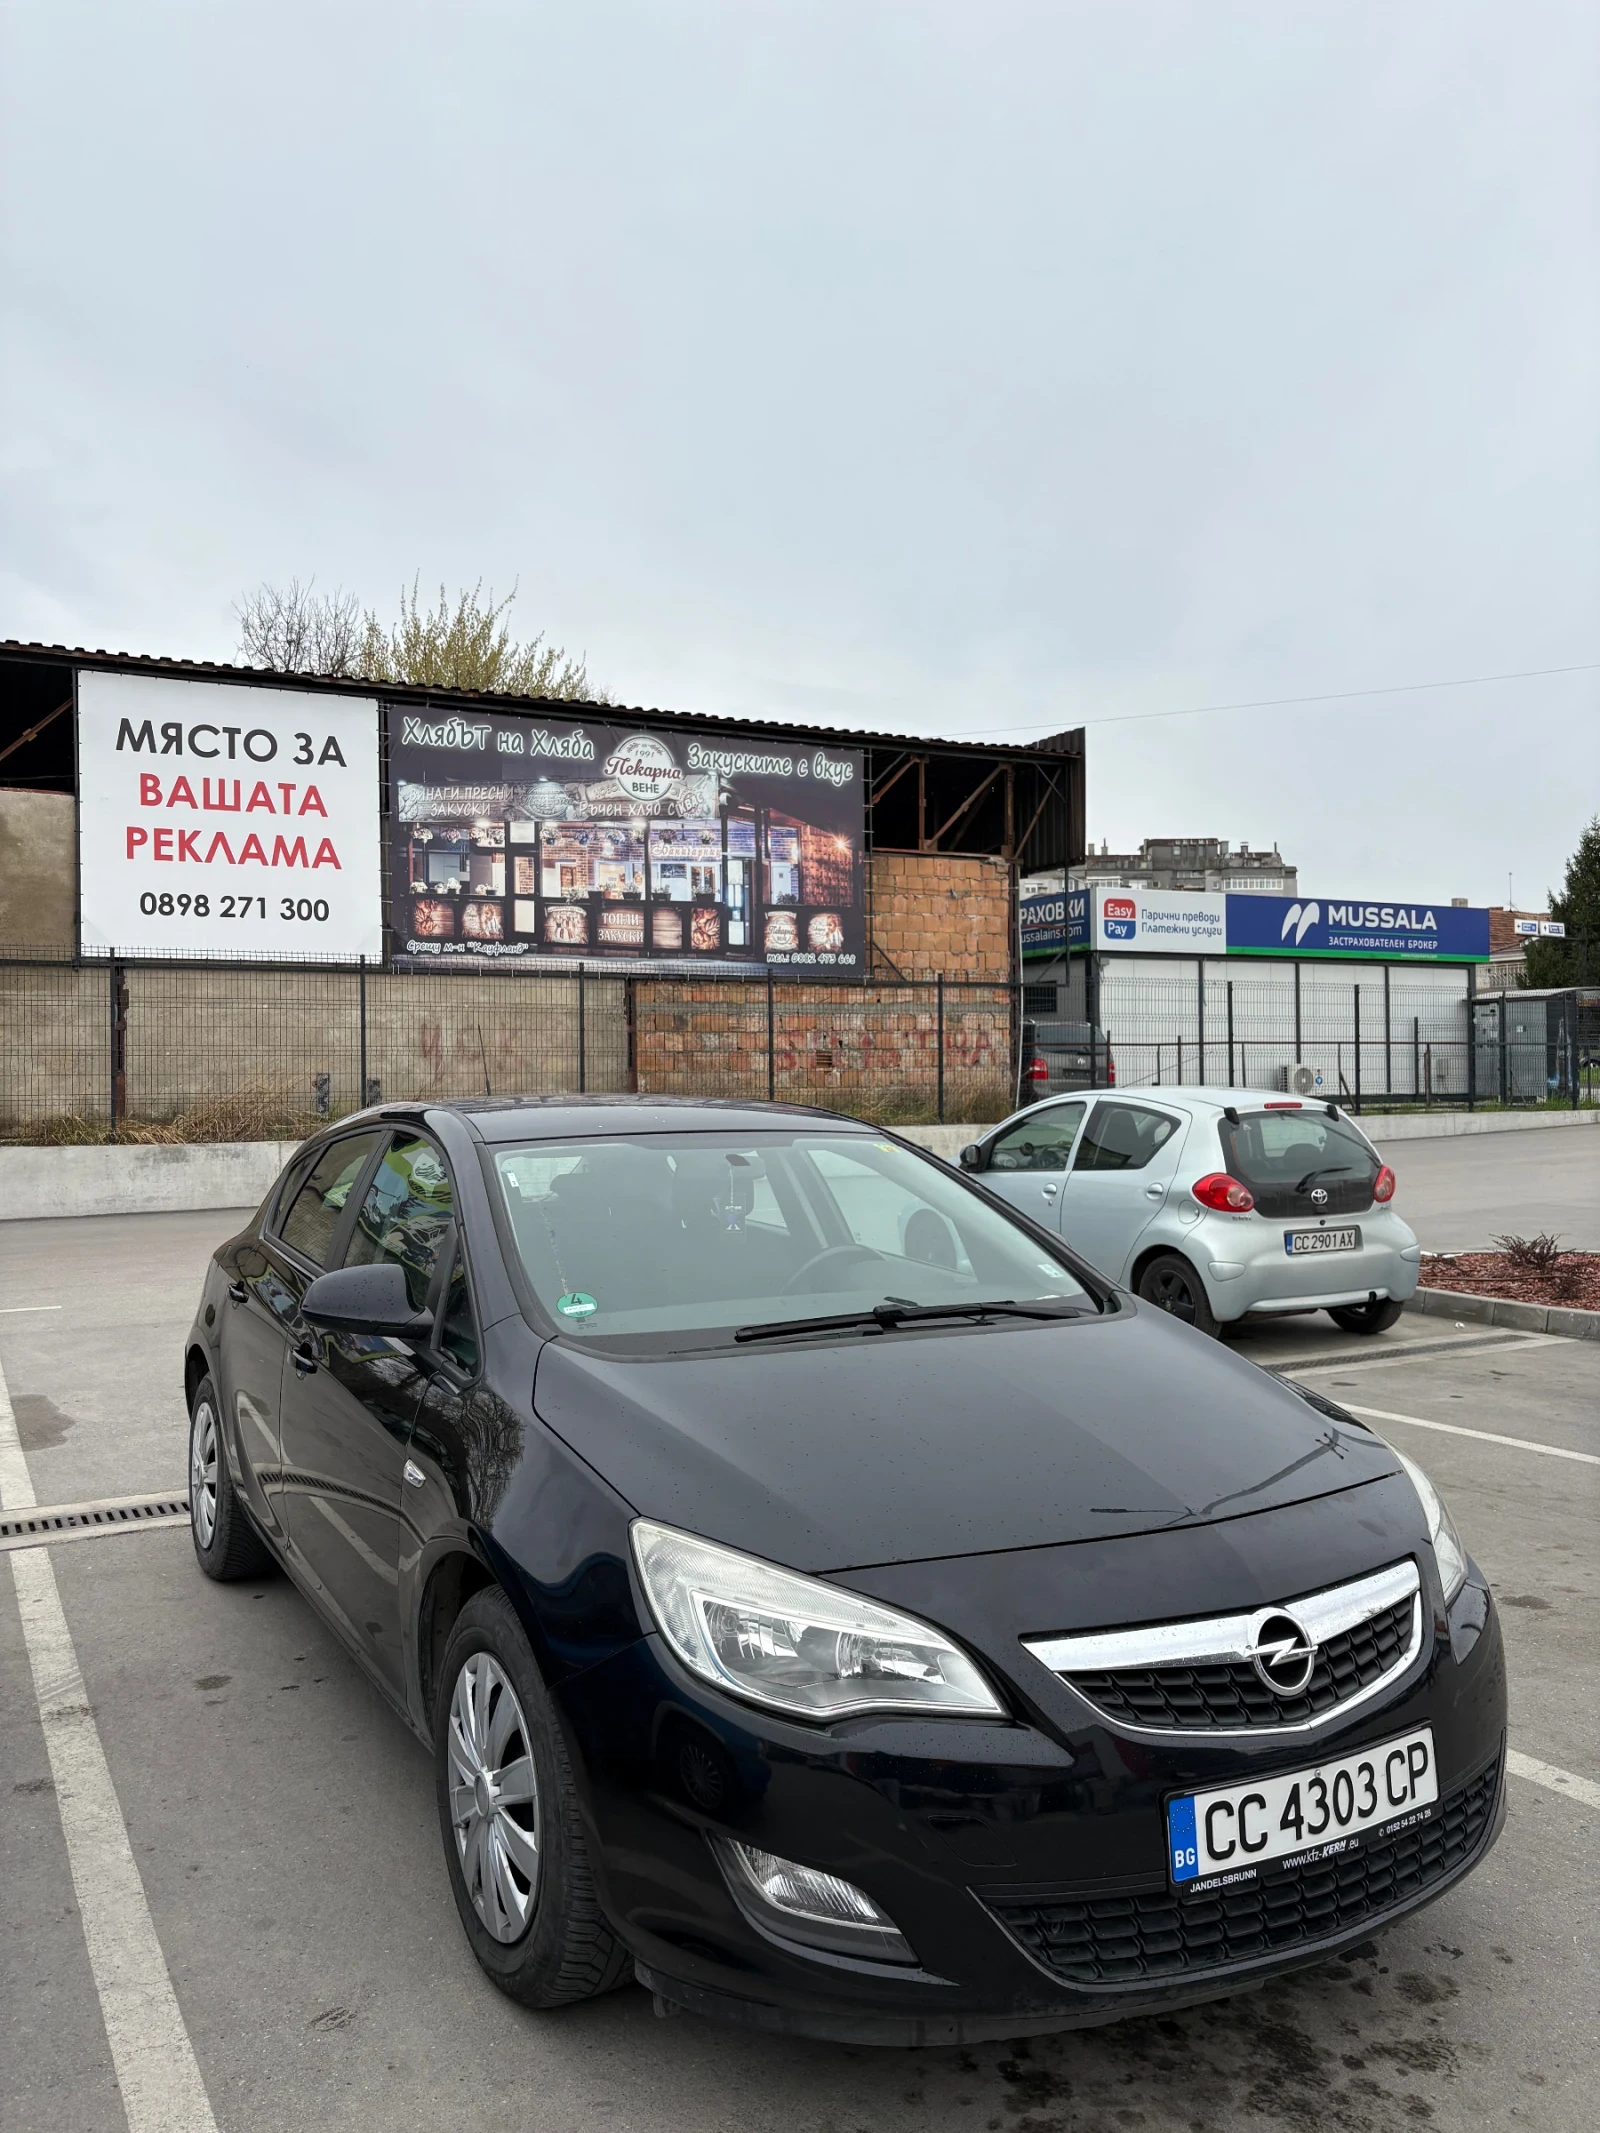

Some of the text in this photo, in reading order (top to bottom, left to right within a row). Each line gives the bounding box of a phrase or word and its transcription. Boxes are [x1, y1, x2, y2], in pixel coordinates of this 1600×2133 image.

[116, 717, 347, 767] МЯСТО ЗА
[498, 732, 524, 754] на
[531, 729, 594, 760] Хляба
[635, 750, 655, 758] 1991
[604, 756, 681, 782] Пекарна
[687, 743, 853, 786] Закуските с вкус
[139, 773, 328, 818] ВАШАТА
[410, 787, 459, 801] ВИНАГИ
[464, 786, 514, 801] ПРЕСНИ
[632, 782, 660, 794] ВЕНЕ
[430, 803, 491, 817] ЗАКУСКИ
[126, 826, 342, 870] РЕКЛАМА
[139, 892, 330, 921] 0898 271 300
[1107, 903, 1133, 919] Easy
[602, 912, 639, 926] ТОПЛИ
[1141, 909, 1220, 925] Парични преводи
[1328, 905, 1437, 930] MUSSALA
[598, 928, 644, 942] ЗАКУСКИ
[1108, 922, 1128, 937] Pay
[1141, 922, 1222, 937] Платежни услуги
[406, 940, 441, 954] Срещу
[1328, 936, 1438, 949] ЗАСТРАХОВАТЕЛЕН БРОКЕР
[1294, 1232, 1354, 1250] CC 2901 AX
[571, 1293, 583, 1304] 4
[1205, 1741, 1429, 1861] CC 4303 CP
[1386, 1822, 1401, 1834] 0152
[1401, 1818, 1409, 1828] 54
[1416, 1812, 1424, 1821] 74
[1174, 1847, 1195, 1868] BG
[1190, 1868, 1257, 1893] JANDELSBRUNN
